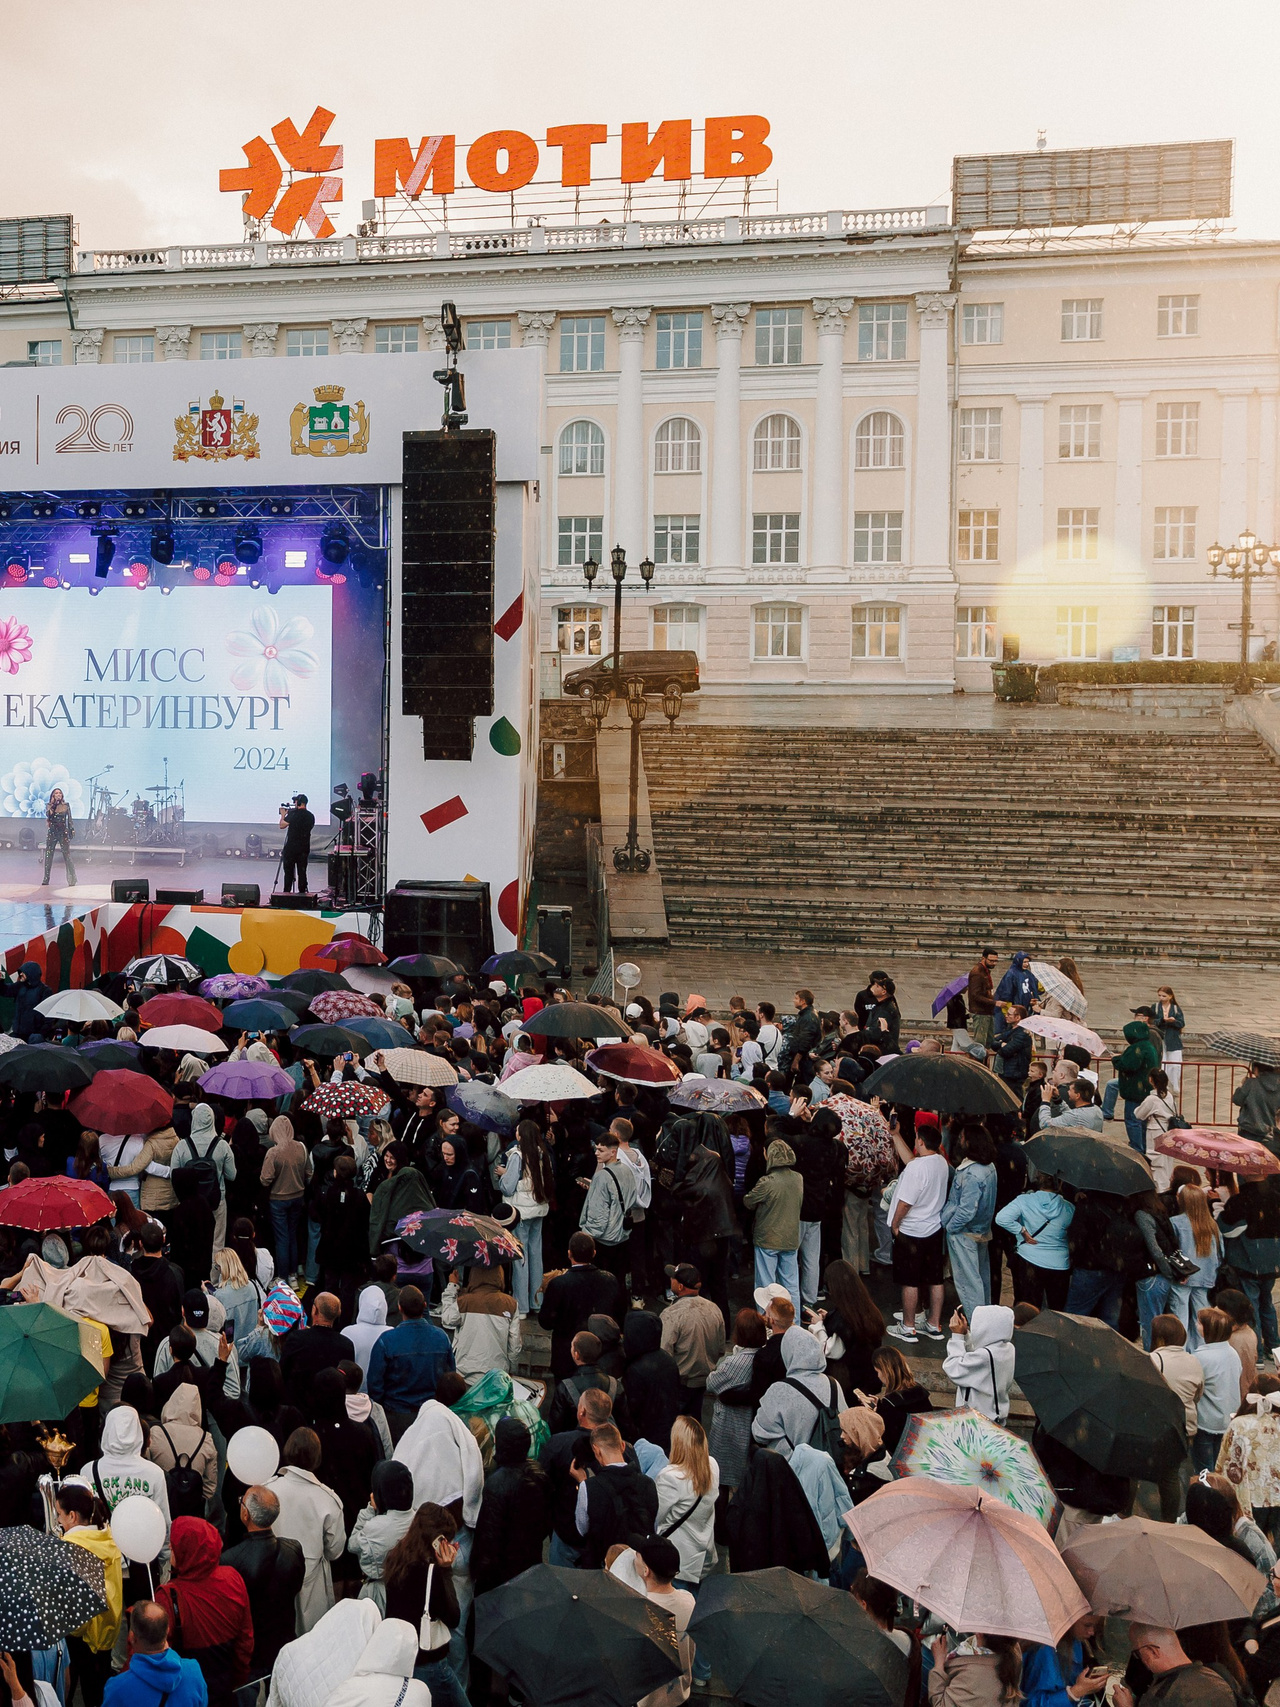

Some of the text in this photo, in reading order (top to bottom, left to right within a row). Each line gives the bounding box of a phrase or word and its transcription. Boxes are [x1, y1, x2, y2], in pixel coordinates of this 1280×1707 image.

[374, 115, 773, 197] МОТИВ
[55, 403, 134, 454] 20 ЛЕТ
[84, 648, 205, 682] МИСС
[3, 693, 290, 730] ЕКАТЕРИНБУРГ
[233, 747, 290, 771] 2024
